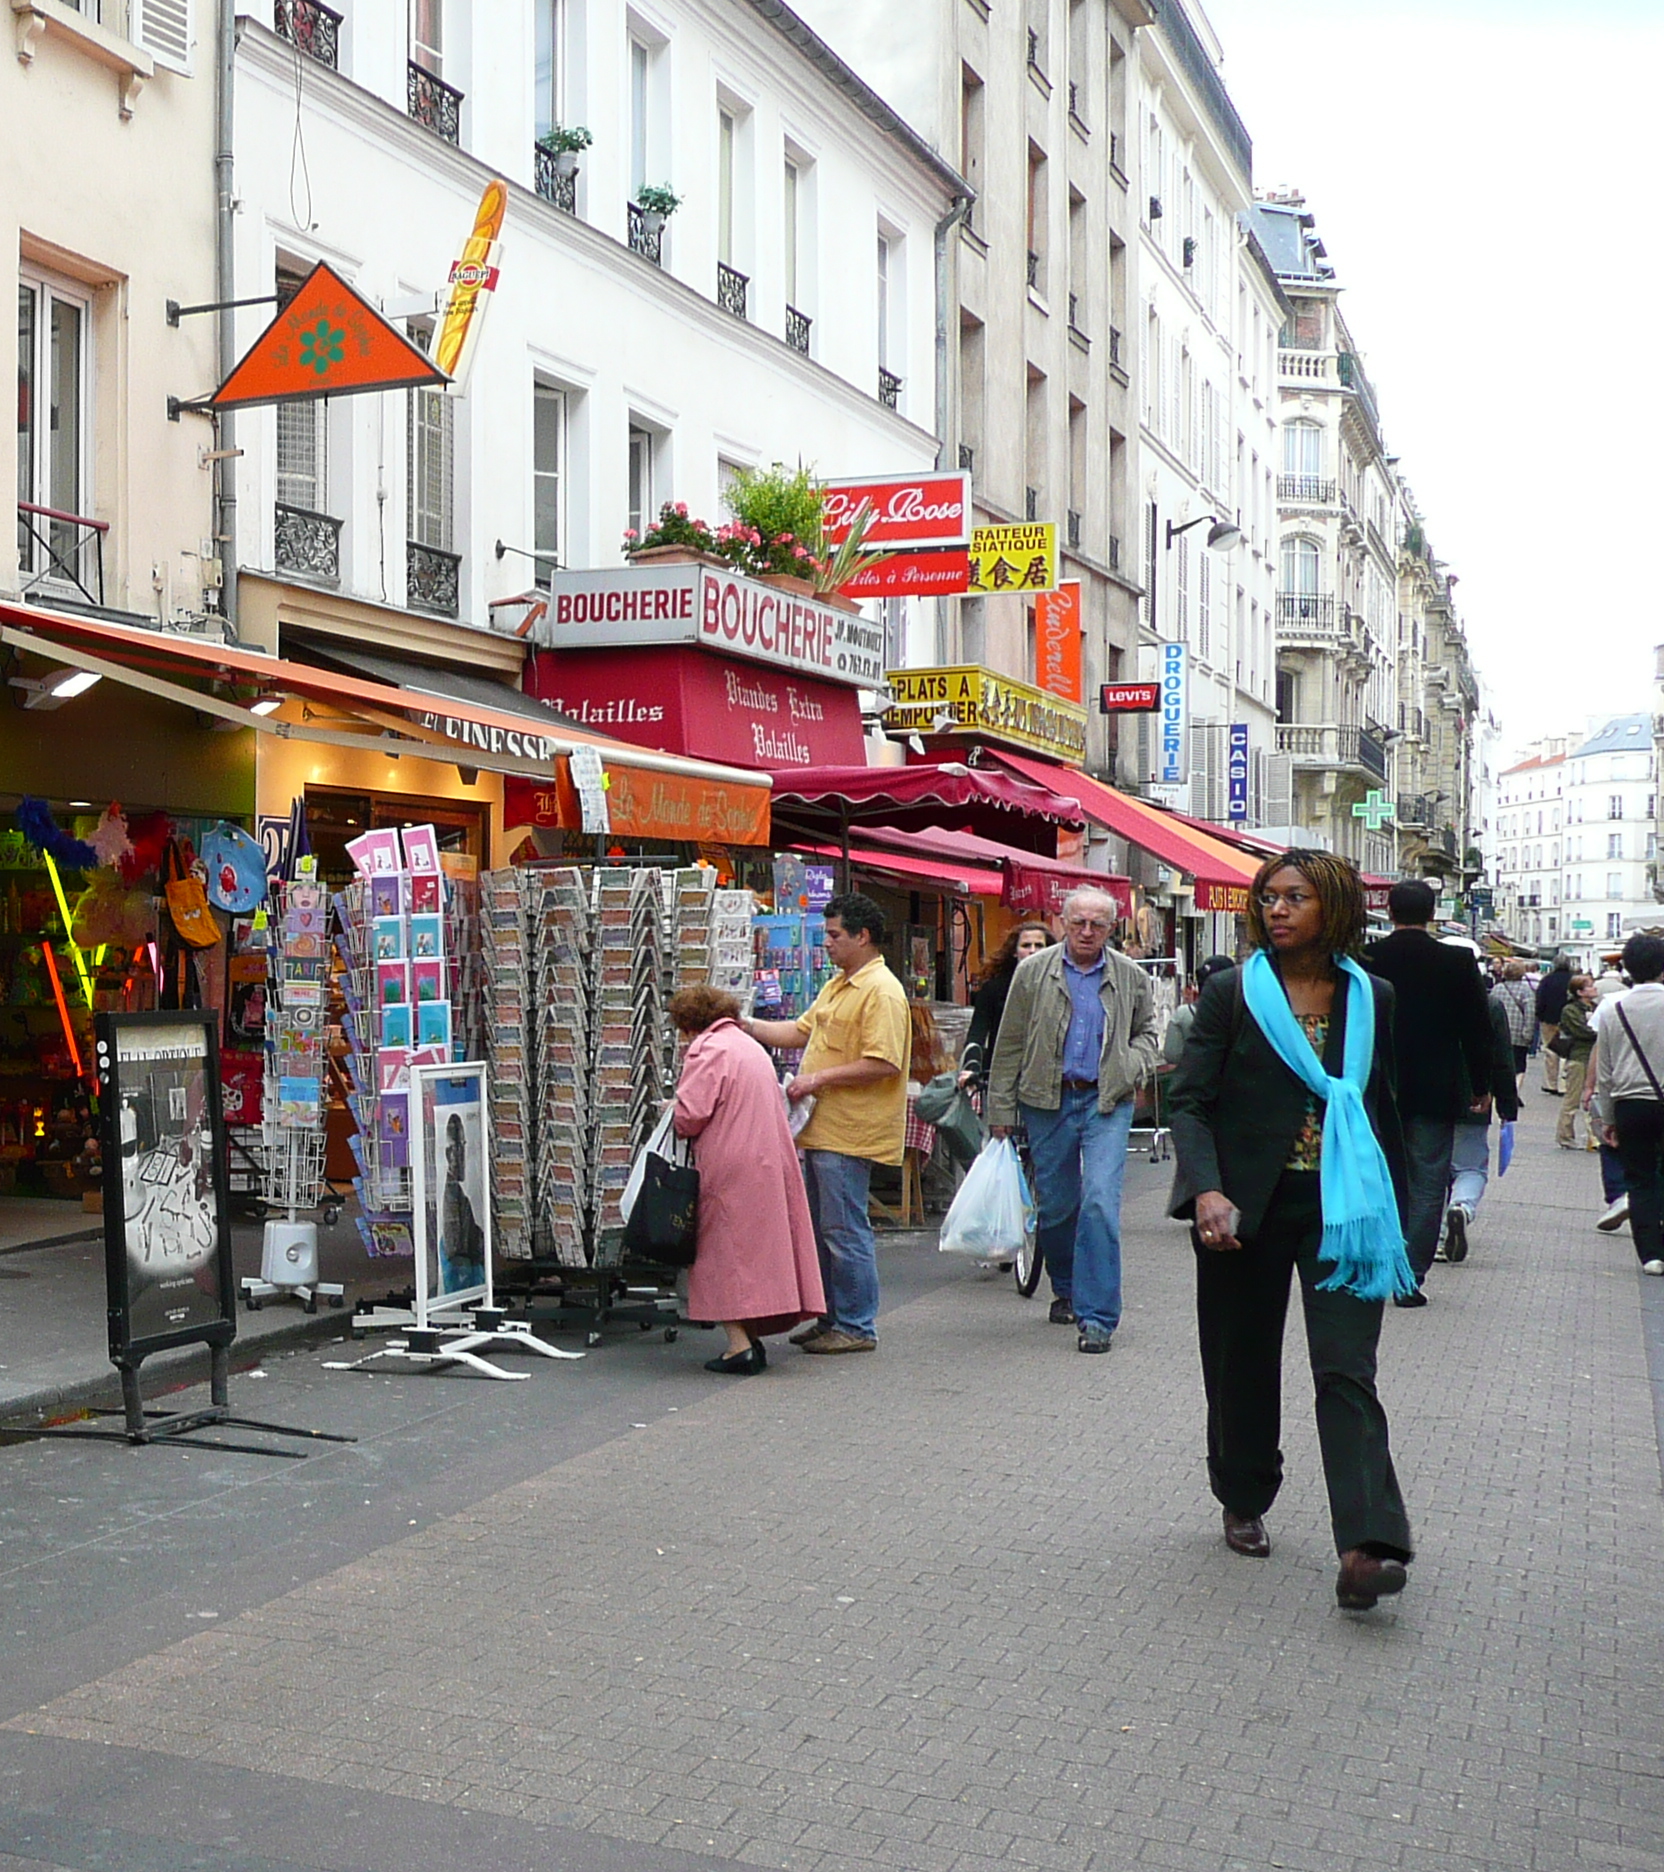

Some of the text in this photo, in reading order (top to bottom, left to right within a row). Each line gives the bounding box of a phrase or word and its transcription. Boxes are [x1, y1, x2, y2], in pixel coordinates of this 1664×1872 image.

[881, 487, 963, 523] Rose
[970, 538, 1048, 554] SIATIQUE
[971, 526, 1045, 542] RAITEUR
[898, 565, 963, 583] Personne
[557, 588, 693, 624] BOUCHERIE
[703, 575, 834, 667] BOUCHERIE
[1045, 590, 1073, 694] Cinderell
[724, 669, 778, 713] Viandes
[897, 675, 970, 700] PLATS A
[1163, 644, 1182, 781] DROGUERIE
[751, 722, 810, 764] Volailles
[1230, 733, 1246, 812] CASIO
